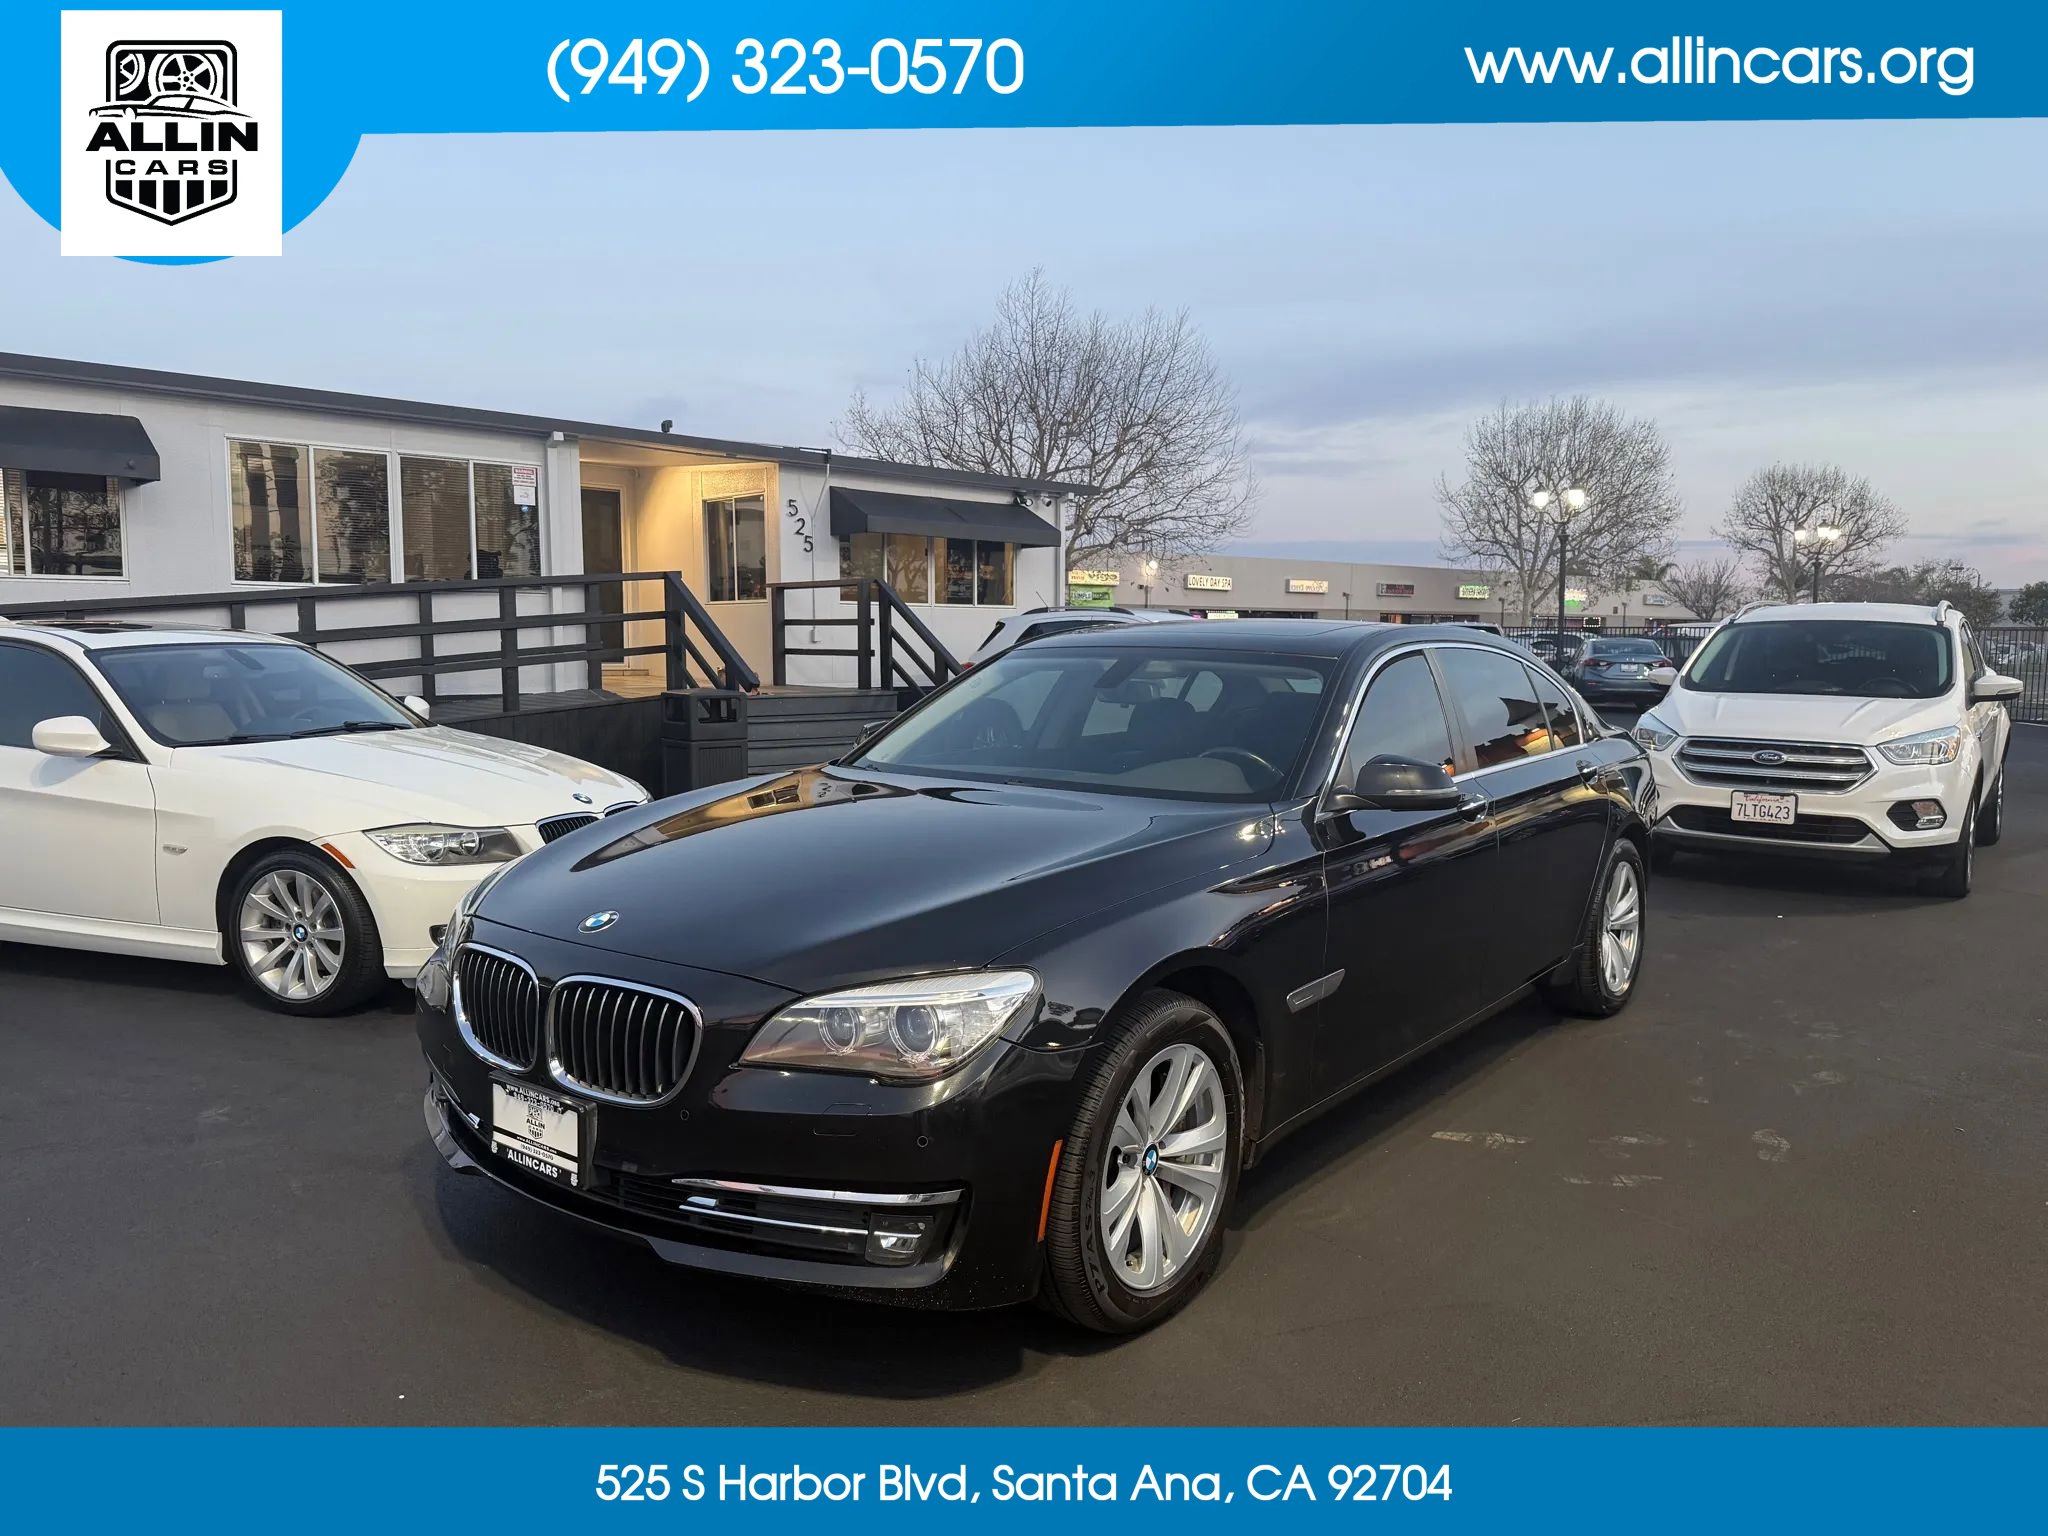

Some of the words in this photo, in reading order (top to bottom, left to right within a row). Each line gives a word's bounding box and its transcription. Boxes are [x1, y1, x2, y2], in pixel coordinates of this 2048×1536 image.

[1189, 576, 1209, 587] LOVELY
[1209, 577, 1221, 588] DAY
[1221, 578, 1232, 589] SPA
[1736, 803, 1790, 820] 7LTG423
[526, 1118, 545, 1130] ALLIN
